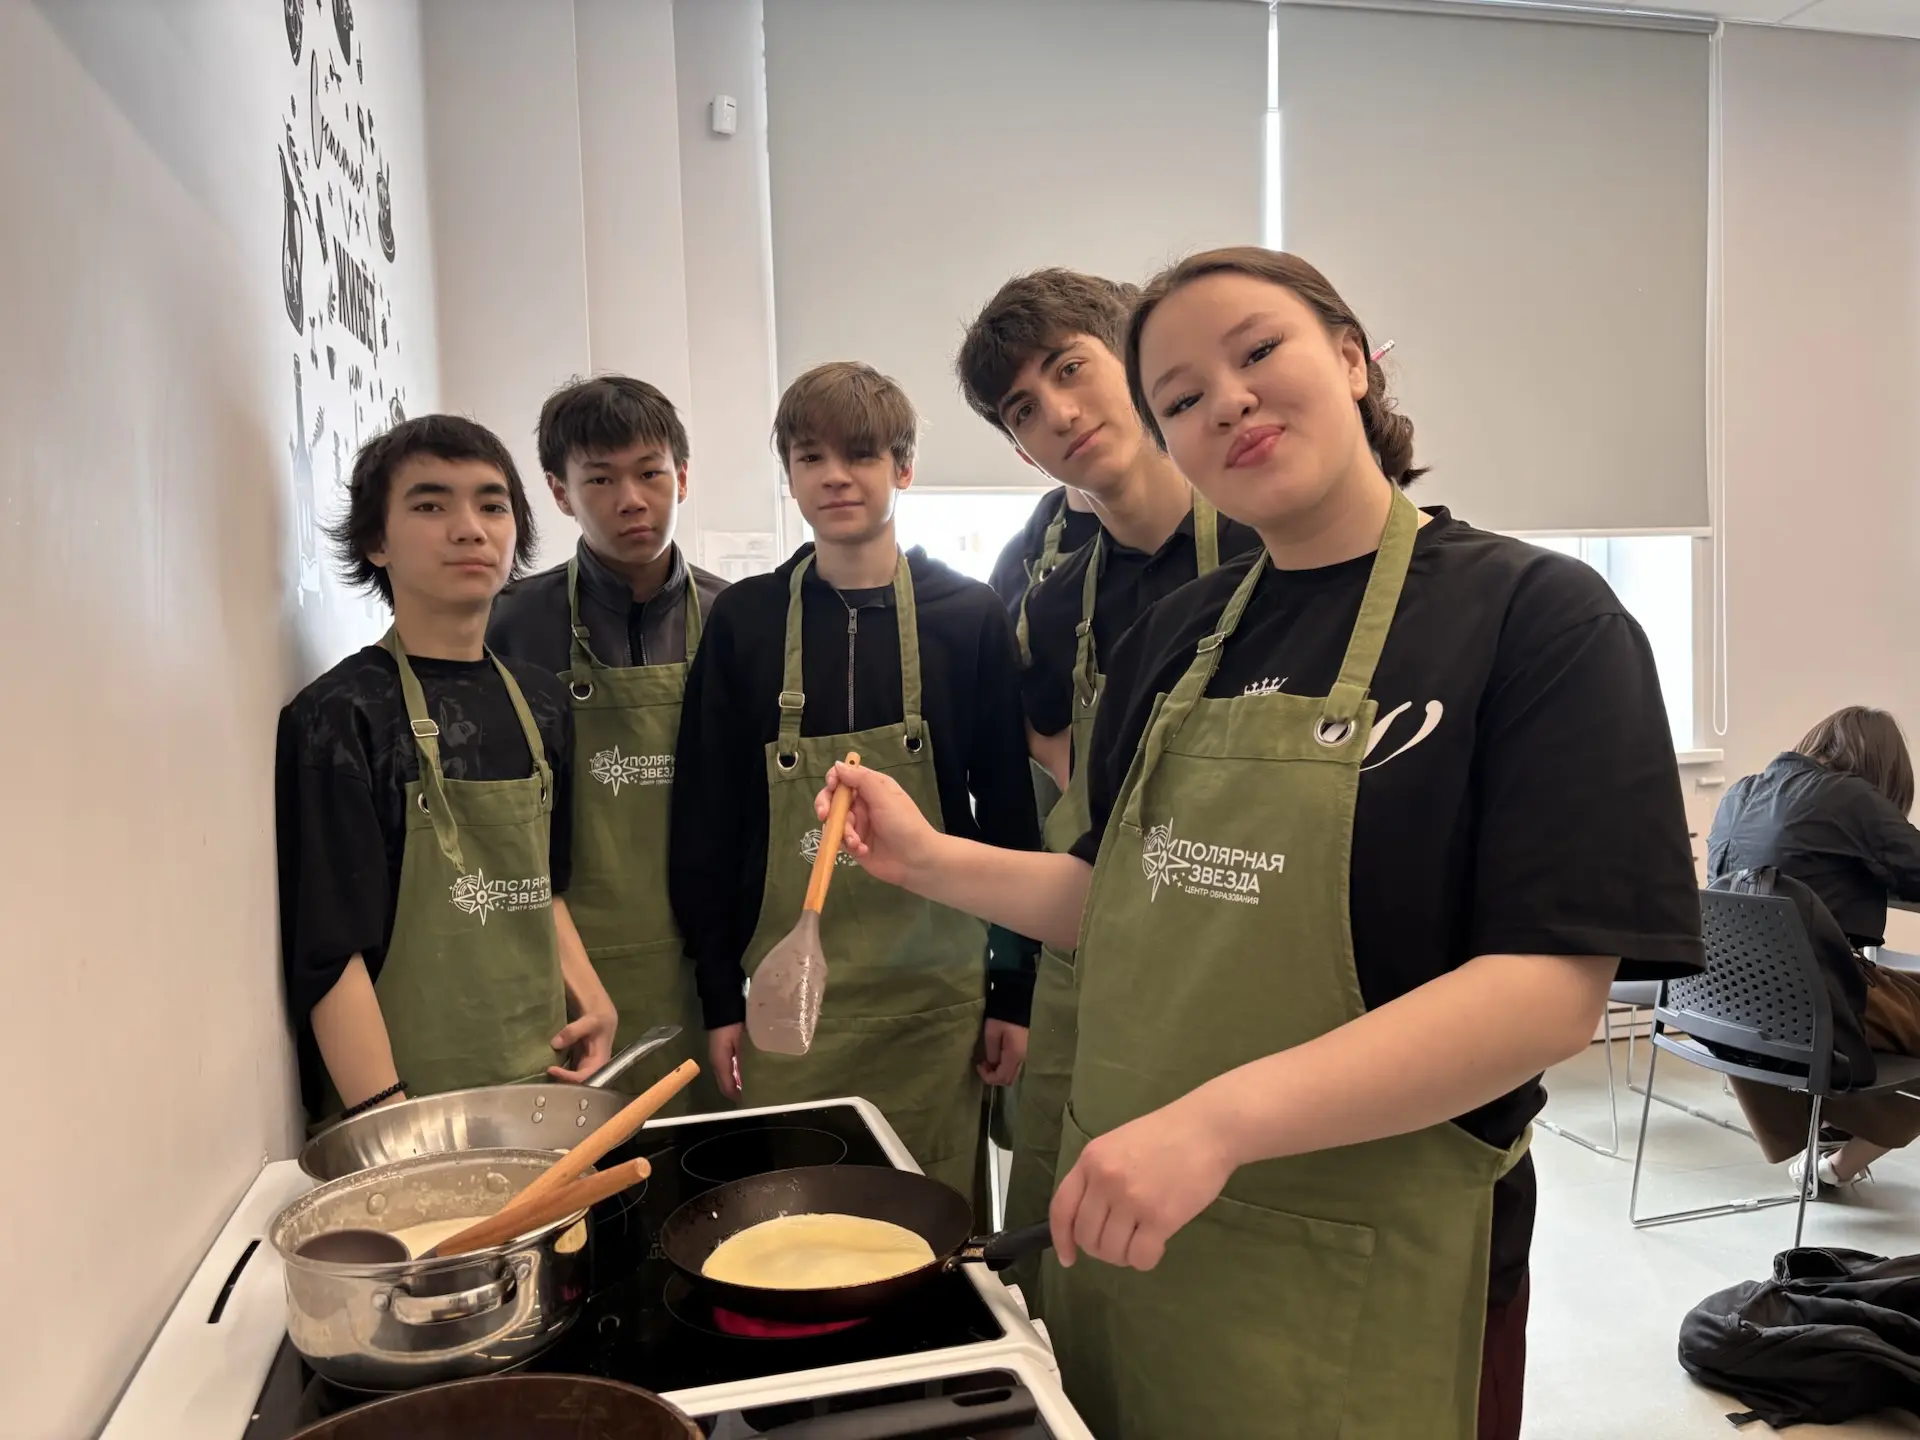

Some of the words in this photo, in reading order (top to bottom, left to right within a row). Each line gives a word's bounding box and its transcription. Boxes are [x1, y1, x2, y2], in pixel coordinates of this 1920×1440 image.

[1176, 839, 1286, 874] ПОЛЯРНАЯ
[1187, 864, 1261, 893] ЗВЕЗДА
[1184, 884, 1209, 896] ЦЕНТР
[1209, 889, 1260, 906] ОБРАЗОВАНИЯ
[507, 904, 527, 912] ЦЕНТР
